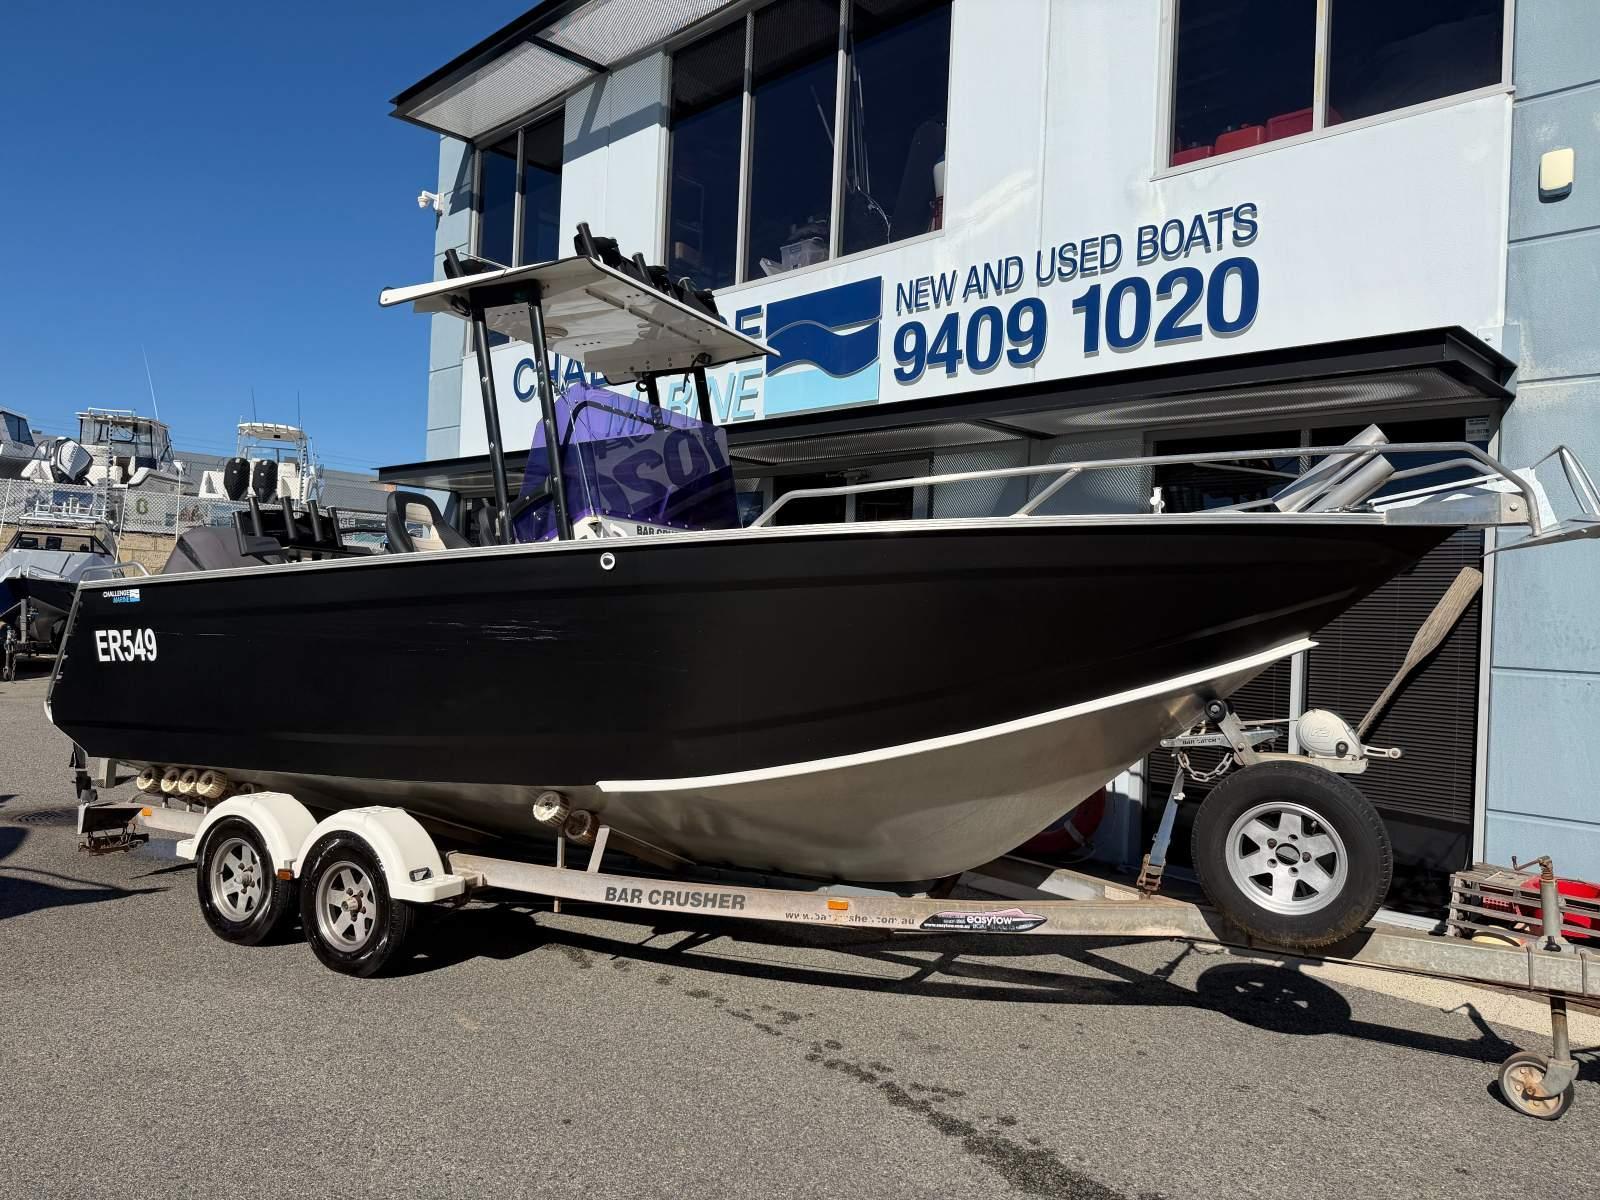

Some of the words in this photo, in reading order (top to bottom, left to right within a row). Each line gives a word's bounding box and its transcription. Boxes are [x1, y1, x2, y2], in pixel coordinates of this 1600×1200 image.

[896, 270, 957, 314] NEW
[963, 255, 1024, 301] AND
[1035, 233, 1122, 284] USED
[1137, 202, 1258, 264] BOATS
[893, 297, 1048, 382] 9409
[1072, 256, 1260, 354] 1020
[636, 525, 655, 536] BAR
[95, 627, 157, 662] ER549
[604, 886, 643, 904] BAR
[647, 889, 746, 911] CRUSHER
[966, 914, 1013, 926] easytow
